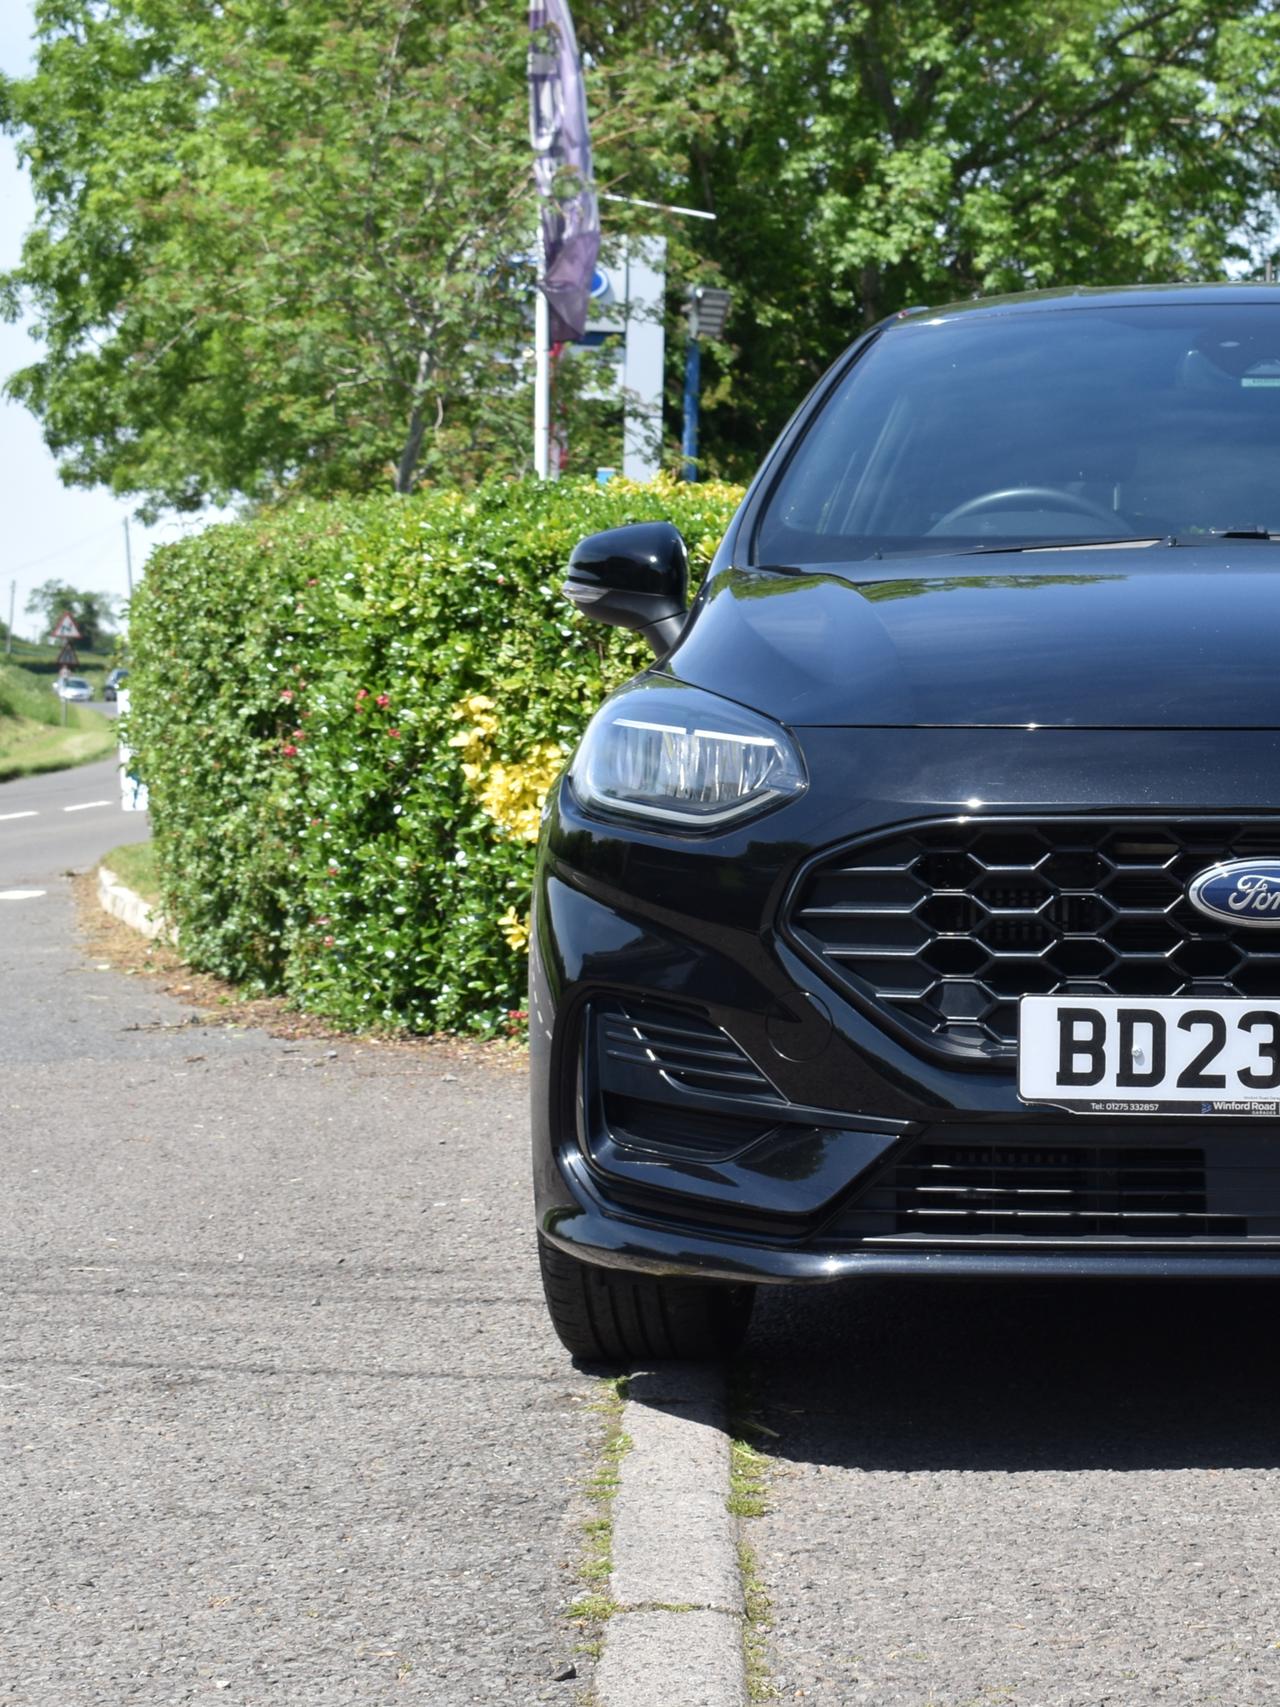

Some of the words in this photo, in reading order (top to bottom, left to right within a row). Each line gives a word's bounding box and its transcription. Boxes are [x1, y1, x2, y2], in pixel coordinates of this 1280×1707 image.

[1091, 1102, 1105, 1111] Tel:
[1106, 1103, 1128, 1111] 01275
[1129, 1103, 1159, 1112] 332857
[1213, 1101, 1250, 1111] Winford
[1251, 1102, 1277, 1111] Road
